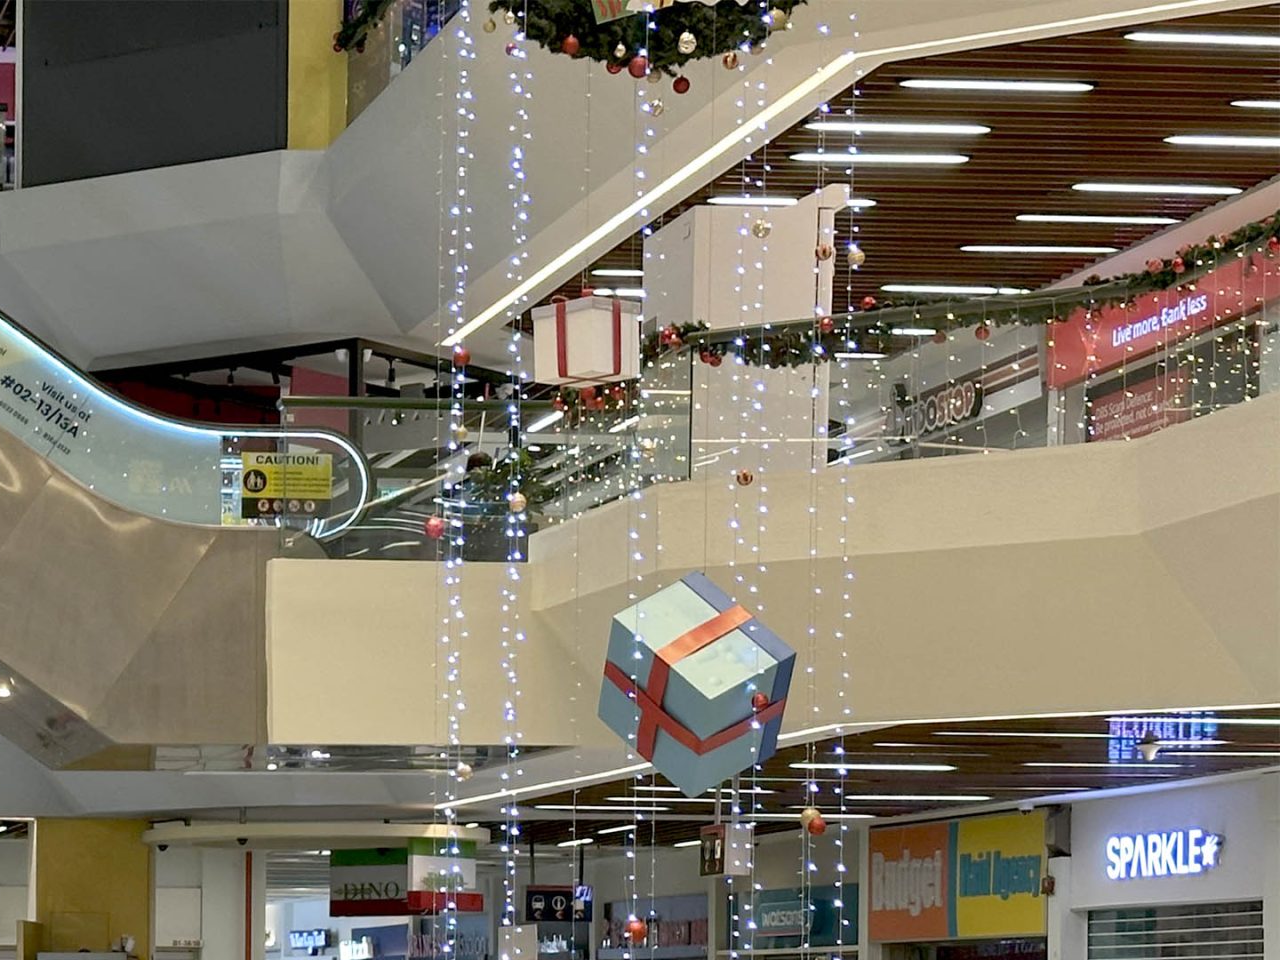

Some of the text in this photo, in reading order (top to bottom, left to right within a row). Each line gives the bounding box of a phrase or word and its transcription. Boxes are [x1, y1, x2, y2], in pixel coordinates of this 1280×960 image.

[1112, 325, 1131, 347] Live
[1133, 314, 1160, 339] more,
[1187, 295, 1207, 316] less
[0, 374, 79, 438] #02-13/13A
[41, 381, 91, 422] Visit us at
[256, 455, 319, 466] CAUTION!
[1106, 828, 1202, 880] SPARKLE
[344, 881, 399, 899] DINO
